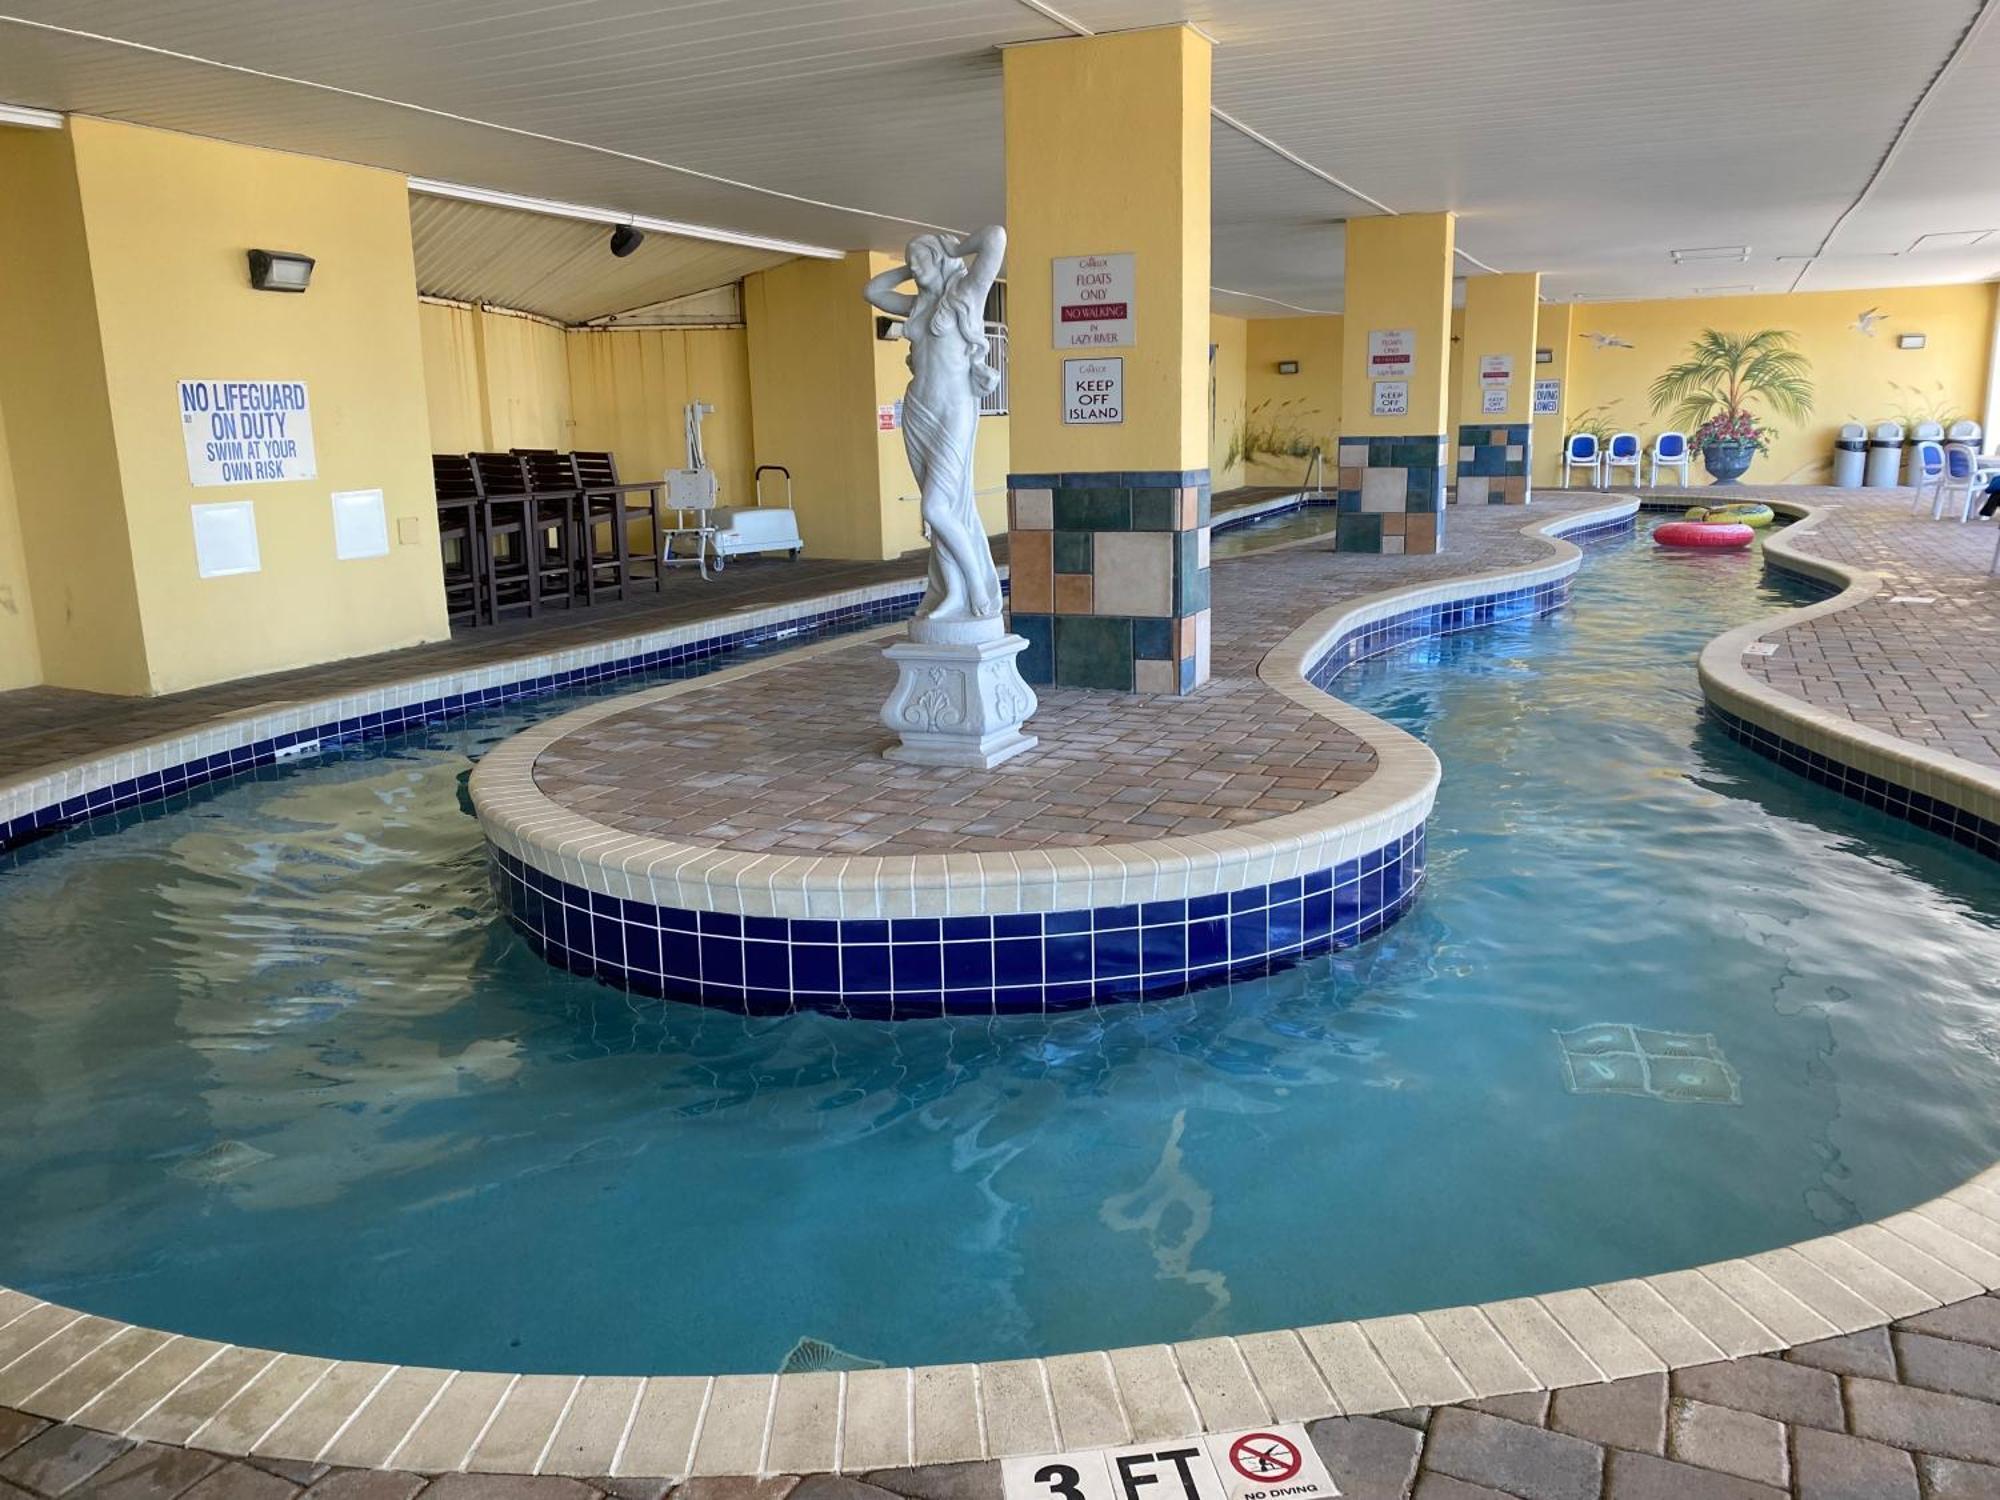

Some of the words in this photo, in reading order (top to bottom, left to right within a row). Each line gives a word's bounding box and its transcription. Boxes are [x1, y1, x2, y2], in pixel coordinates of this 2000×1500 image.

[1076, 273, 1112, 287] FLOATS
[1080, 288, 1107, 301] ONLY
[1065, 308, 1080, 320] NO
[1081, 306, 1124, 319] WALKING
[1090, 324, 1098, 332] IN
[1071, 334, 1092, 345] LAZY
[1093, 332, 1118, 343] RIVER
[1076, 379, 1114, 392] KEEP
[182, 383, 208, 411] NO
[213, 383, 305, 411] LIFEGUARD
[1078, 394, 1109, 406] OFF
[1381, 392, 1403, 400] KEEP
[1069, 407, 1118, 420] ISLAND
[211, 413, 237, 441] ON
[241, 412, 286, 440] DUTY
[206, 442, 244, 462] SWIM
[247, 441, 260, 460] AT
[264, 440, 297, 459] YOUR
[222, 462, 252, 482] OWN
[256, 460, 285, 480] RISK
[1034, 1464, 1086, 1500] 3
[1115, 1447, 1201, 1500] FT
[1244, 1491, 1266, 1500] NO
[1269, 1484, 1318, 1498] DIVING
